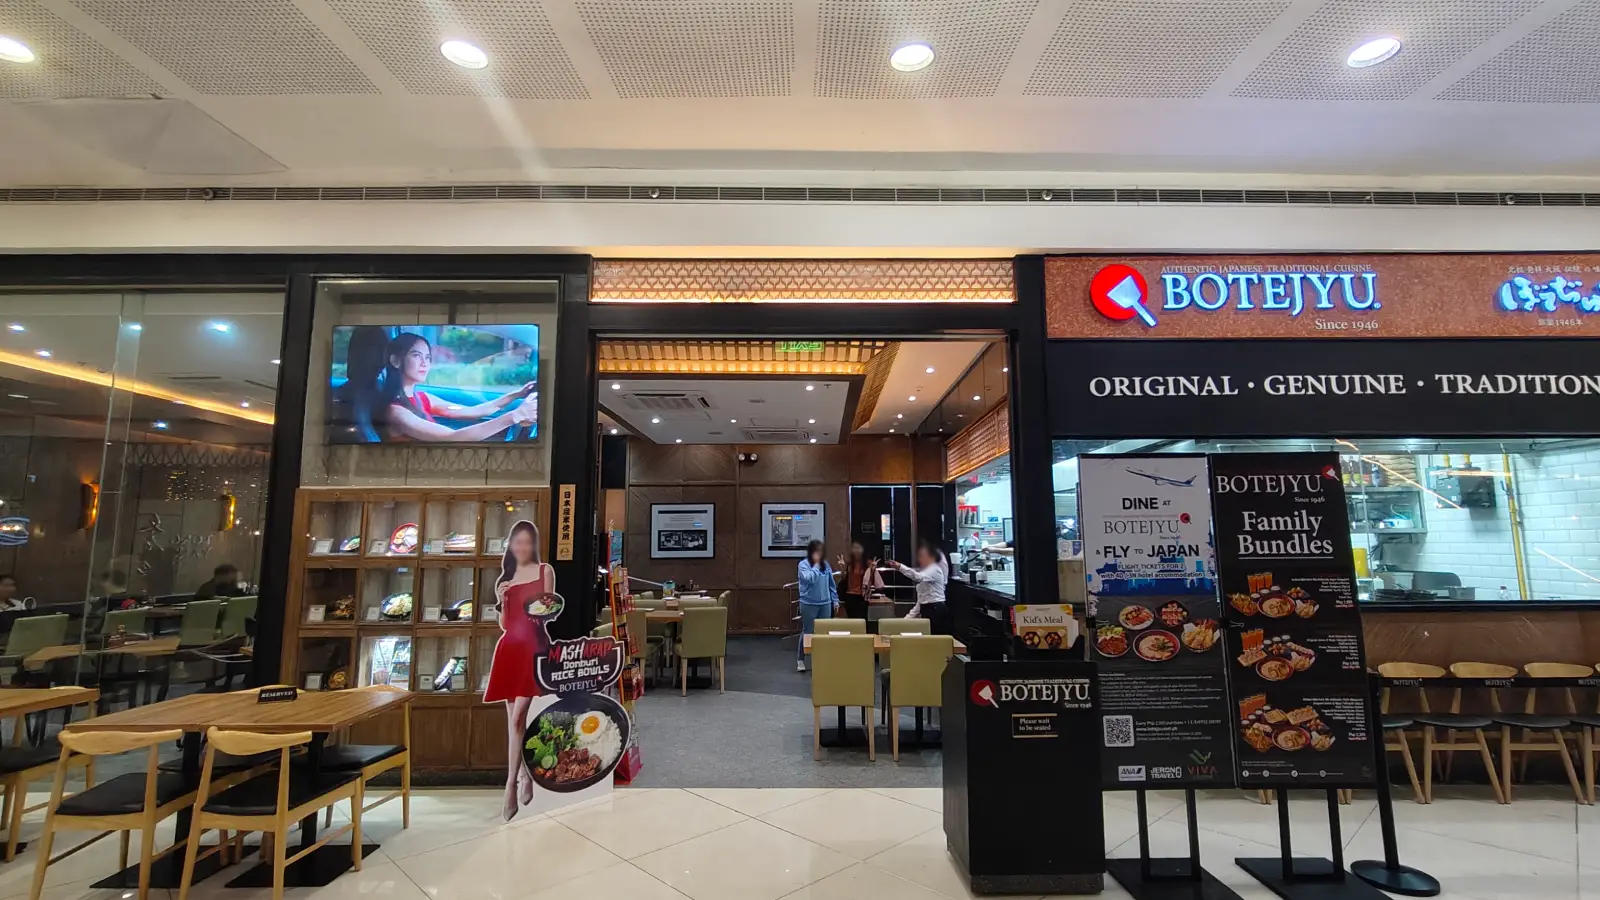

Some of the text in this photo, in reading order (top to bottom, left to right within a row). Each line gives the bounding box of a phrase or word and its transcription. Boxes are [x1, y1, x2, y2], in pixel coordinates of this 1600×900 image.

[1160, 264, 1372, 274] AUTHENTIC JAPANESE TRADITIONAL CUISINE
[1315, 318, 1379, 331] Since 1946
[1089, 375, 1239, 397] ORIGINAL
[1263, 374, 1407, 396] GENUINE
[1122, 497, 1159, 510] DINE
[1241, 509, 1323, 537] Family
[1237, 533, 1334, 555] Bundles
[1103, 545, 1131, 559] FLY
[1147, 544, 1200, 558] JAPAN
[1022, 615, 1063, 624] Kid's Meal
[563, 657, 599, 670] Donburi
[551, 664, 610, 682] RICE BOWLS
[1121, 767, 1136, 775] ANA
[1187, 765, 1218, 775] VIVA
